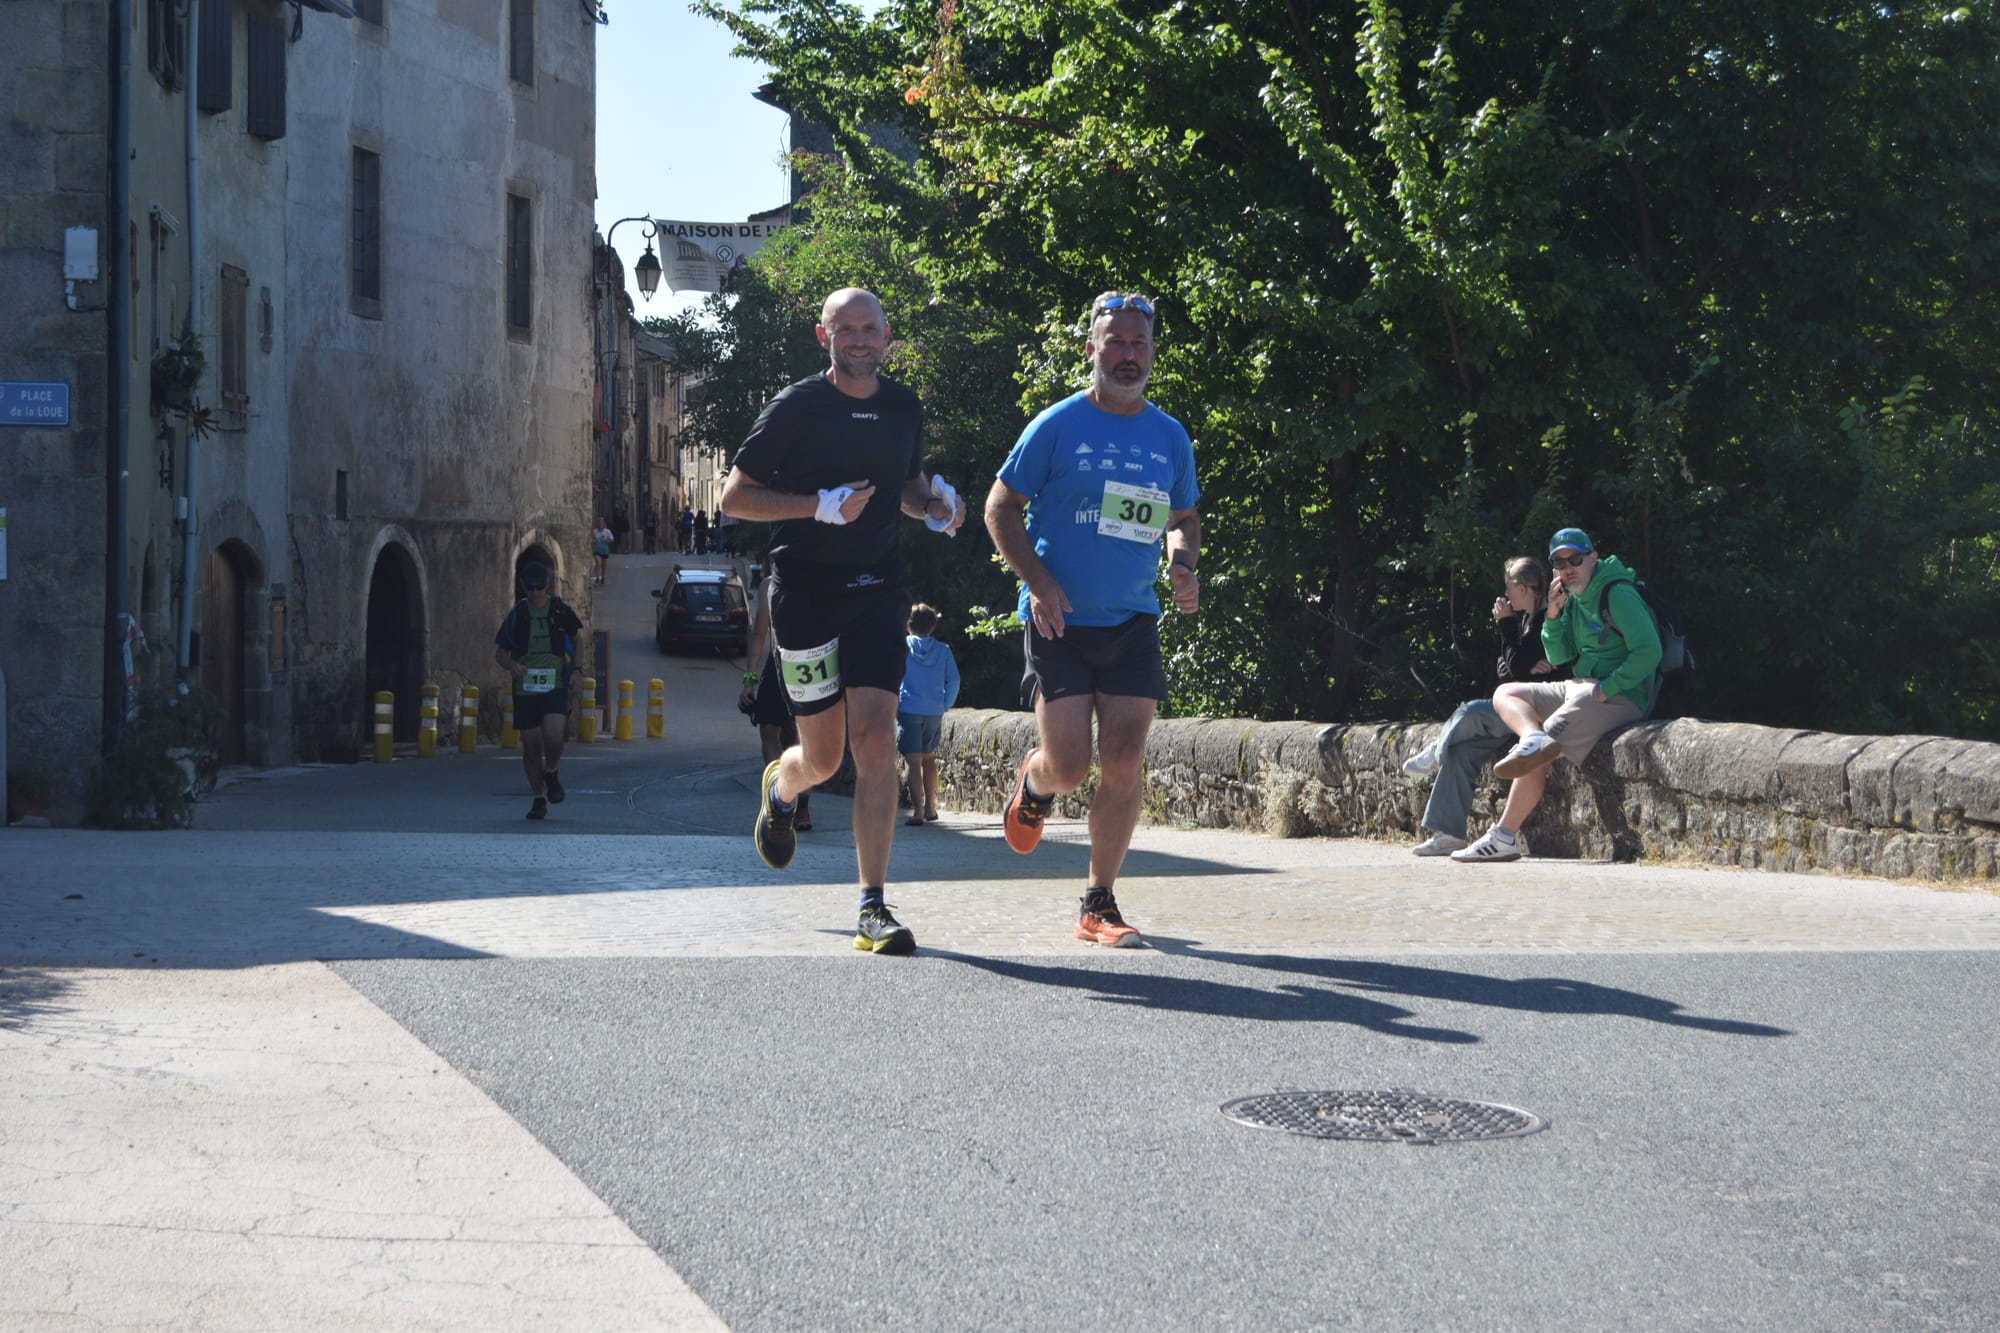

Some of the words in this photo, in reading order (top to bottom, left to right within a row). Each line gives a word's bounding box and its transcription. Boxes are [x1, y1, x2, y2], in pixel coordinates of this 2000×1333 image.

[662, 224, 734, 238] MAISON
[739, 225, 762, 238] DE
[21, 390, 53, 402] PLACE
[10, 405, 22, 417] de
[25, 406, 34, 417] la
[38, 406, 63, 417] LOUE
[1118, 499, 1153, 525] 30
[795, 659, 828, 685] 31
[531, 674, 548, 685] 15
